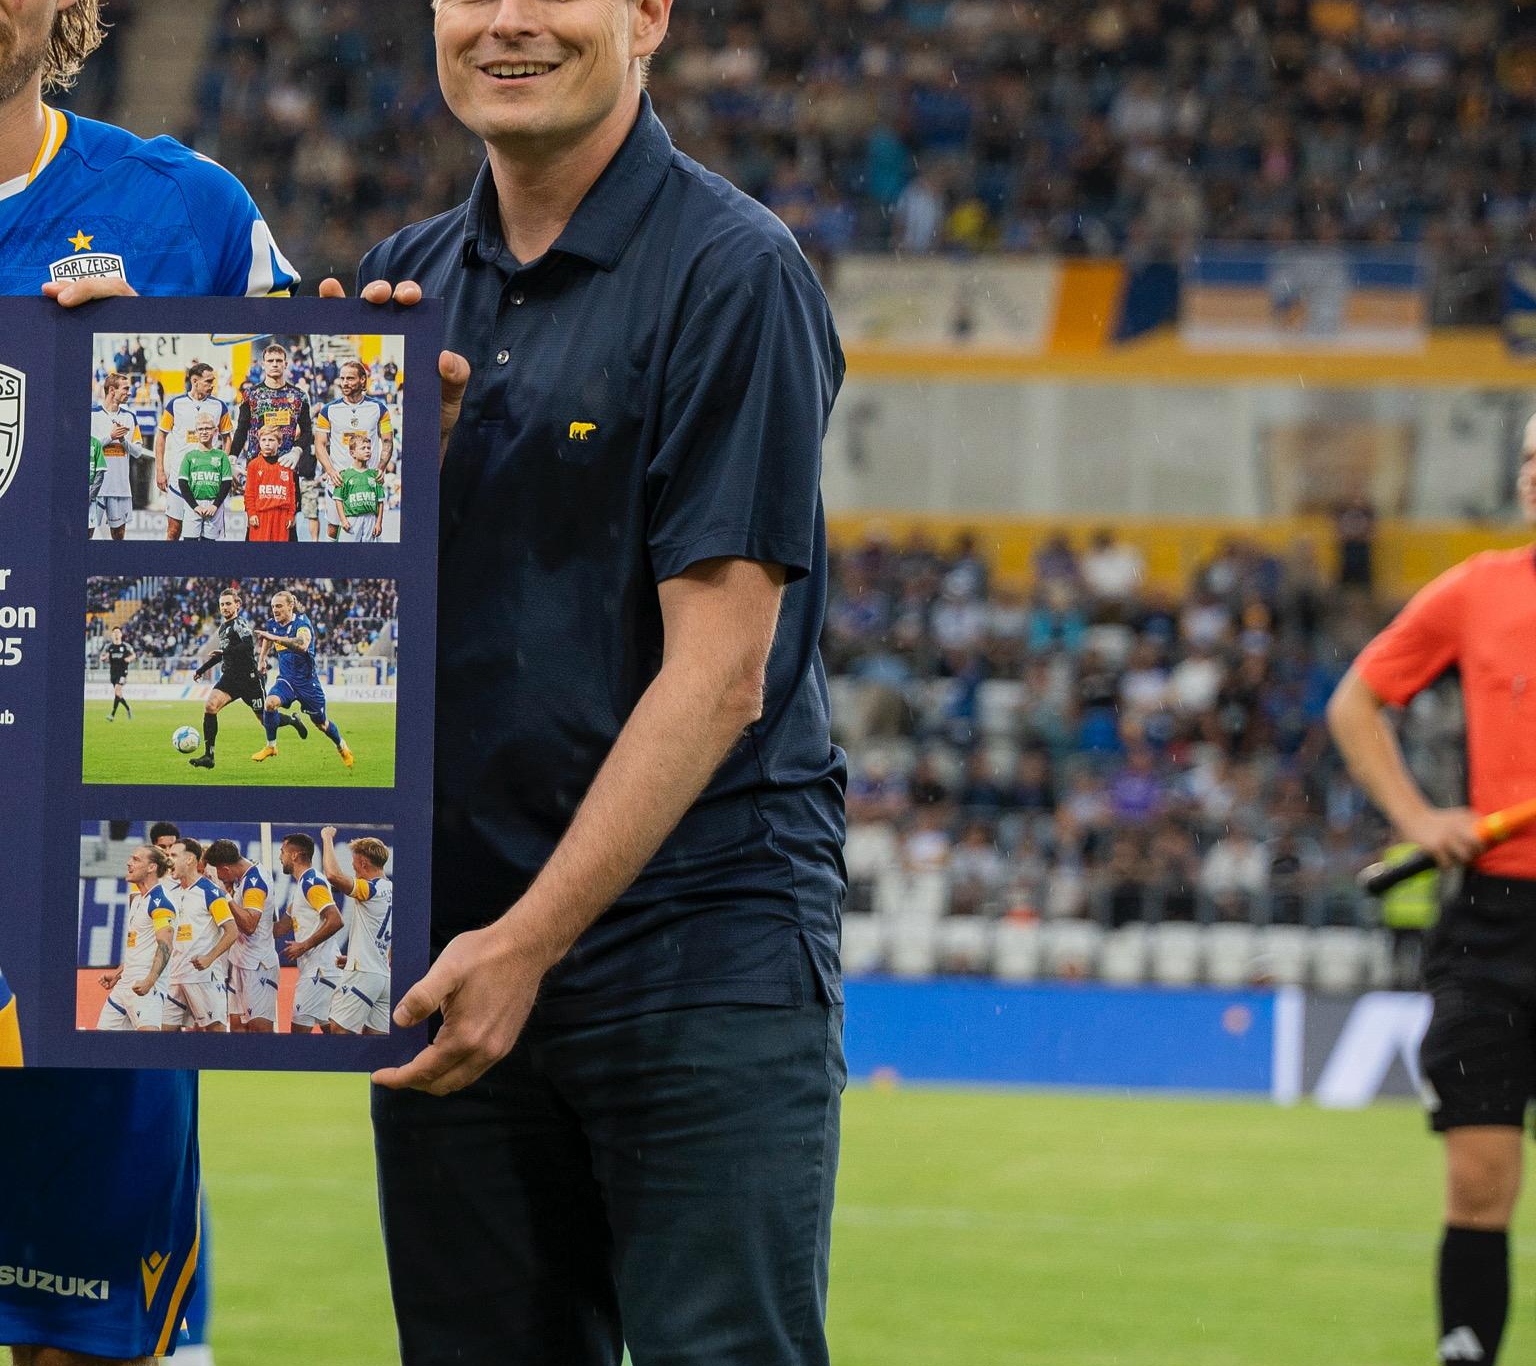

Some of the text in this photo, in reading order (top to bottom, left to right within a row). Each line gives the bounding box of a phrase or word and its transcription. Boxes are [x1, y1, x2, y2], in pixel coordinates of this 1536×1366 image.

[56, 258, 118, 276] CARL ZEISS
[191, 471, 221, 482] REWE
[259, 484, 287, 496] REWE
[349, 491, 376, 502] REWE
[251, 698, 262, 709] 20
